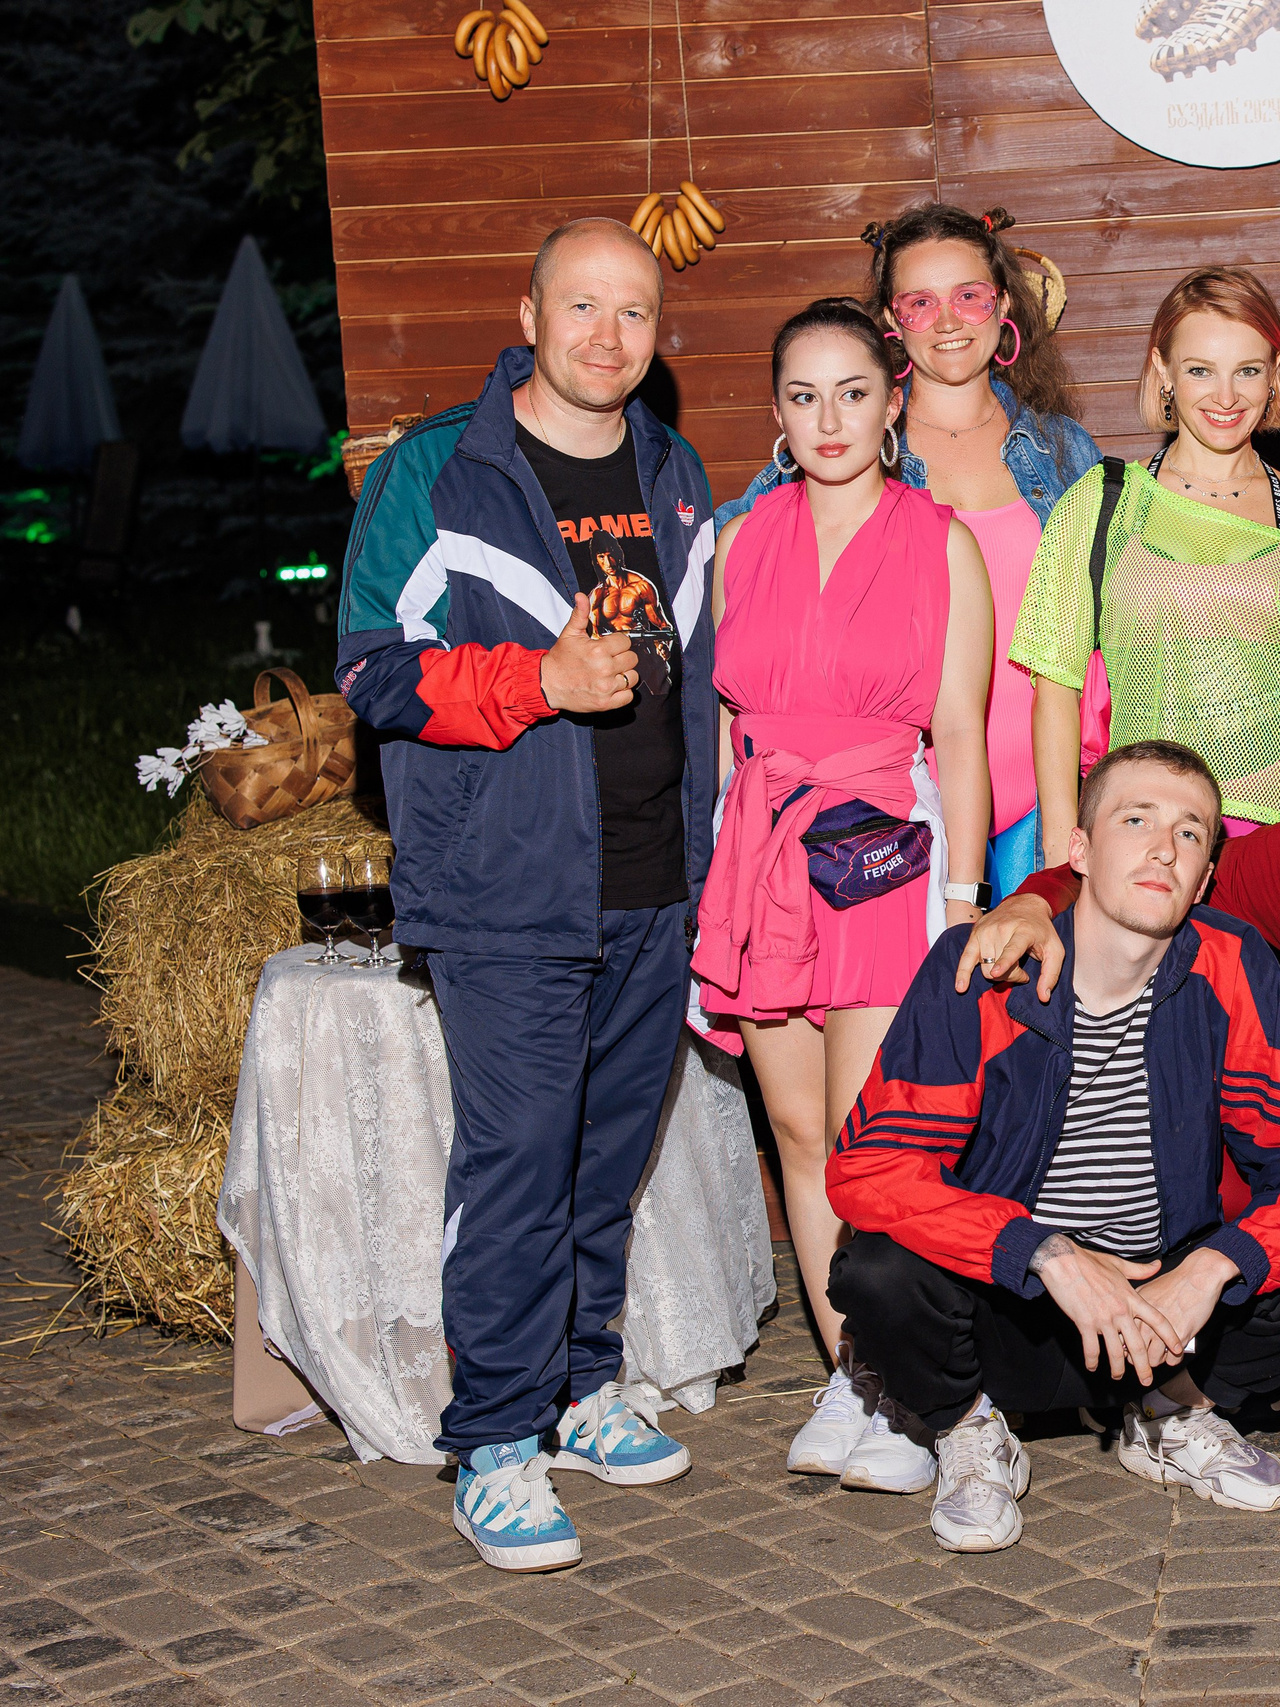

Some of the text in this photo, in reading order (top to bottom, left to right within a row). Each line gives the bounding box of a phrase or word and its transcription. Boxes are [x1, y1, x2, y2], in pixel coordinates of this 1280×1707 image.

[1243, 97, 1280, 123] 2024
[556, 513, 653, 543] RAMB
[863, 841, 899, 865] ГОНКА
[864, 853, 904, 880] ГЕРОЕВ
